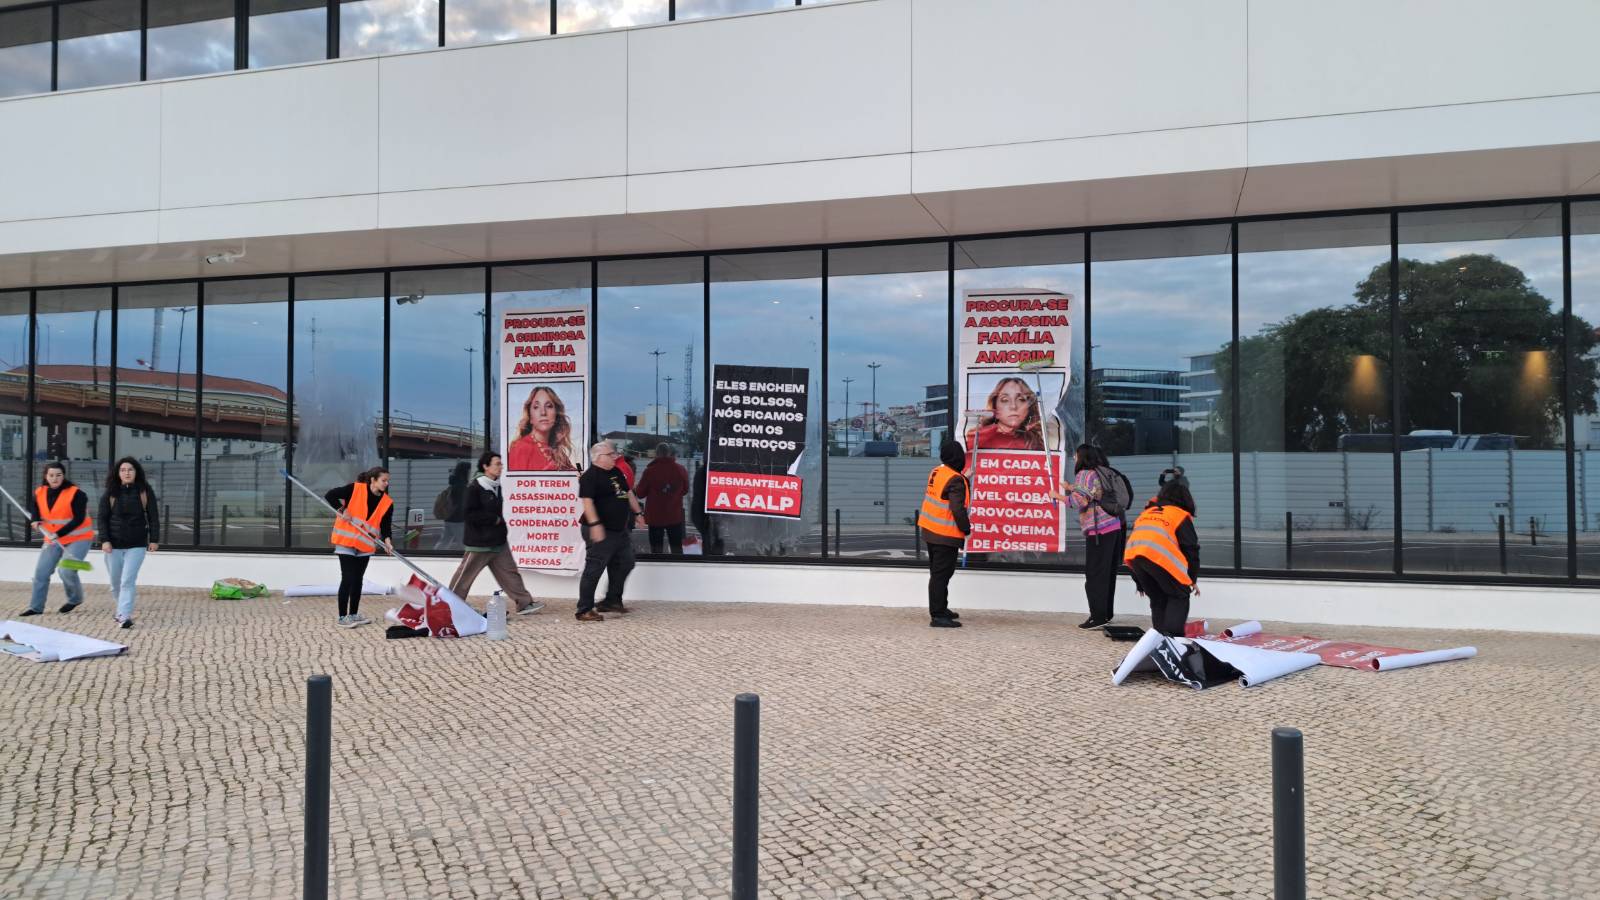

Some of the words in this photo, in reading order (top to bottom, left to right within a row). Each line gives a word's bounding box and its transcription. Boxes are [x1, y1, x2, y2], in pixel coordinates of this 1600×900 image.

[966, 299, 1068, 312] PROCURA-SE
[505, 316, 585, 329] PROCURA-SE
[964, 317, 977, 328] A
[977, 315, 1069, 327] ASSASSINA
[504, 333, 515, 343] A
[516, 330, 585, 342] CRIMINOSA
[978, 328, 1054, 344] FAMÍLIA
[515, 342, 575, 357] FAMÍLIA
[975, 350, 1054, 363] AMORIM
[513, 361, 576, 374] AMORIM
[716, 380, 747, 391] ELES
[749, 382, 805, 393] ENCHEM
[722, 395, 740, 404] OS
[742, 395, 797, 409] BOLSOS,
[714, 407, 742, 418] NÓS
[743, 409, 804, 422] FICAMOS
[733, 423, 763, 434] COM
[765, 425, 783, 435] OS
[718, 437, 796, 451] DESTROÇOS
[980, 459, 999, 469] EM
[1002, 459, 1041, 470] CADA
[517, 480, 537, 488] POR
[539, 480, 570, 488] TEREM
[710, 476, 798, 490] DESMANTELAR
[977, 475, 1031, 485] MORTES
[1034, 476, 1045, 486] A
[509, 493, 578, 502] ASSASSINADO,
[714, 492, 731, 507] A
[735, 493, 794, 511] GALP
[1005, 491, 1056, 502] GLOBA
[512, 506, 567, 514] DESPEJADO
[569, 506, 575, 514] E
[970, 507, 1054, 519] PROVOCADA
[509, 519, 569, 527] CONDENADO
[527, 532, 559, 540] MORTE
[1002, 524, 1056, 536] QUEIMA
[511, 545, 558, 553] MILHARES
[560, 545, 574, 553] DE
[972, 539, 991, 549] DE
[993, 538, 1047, 551] FÓSSEIS
[519, 558, 561, 566] PESSOAS
